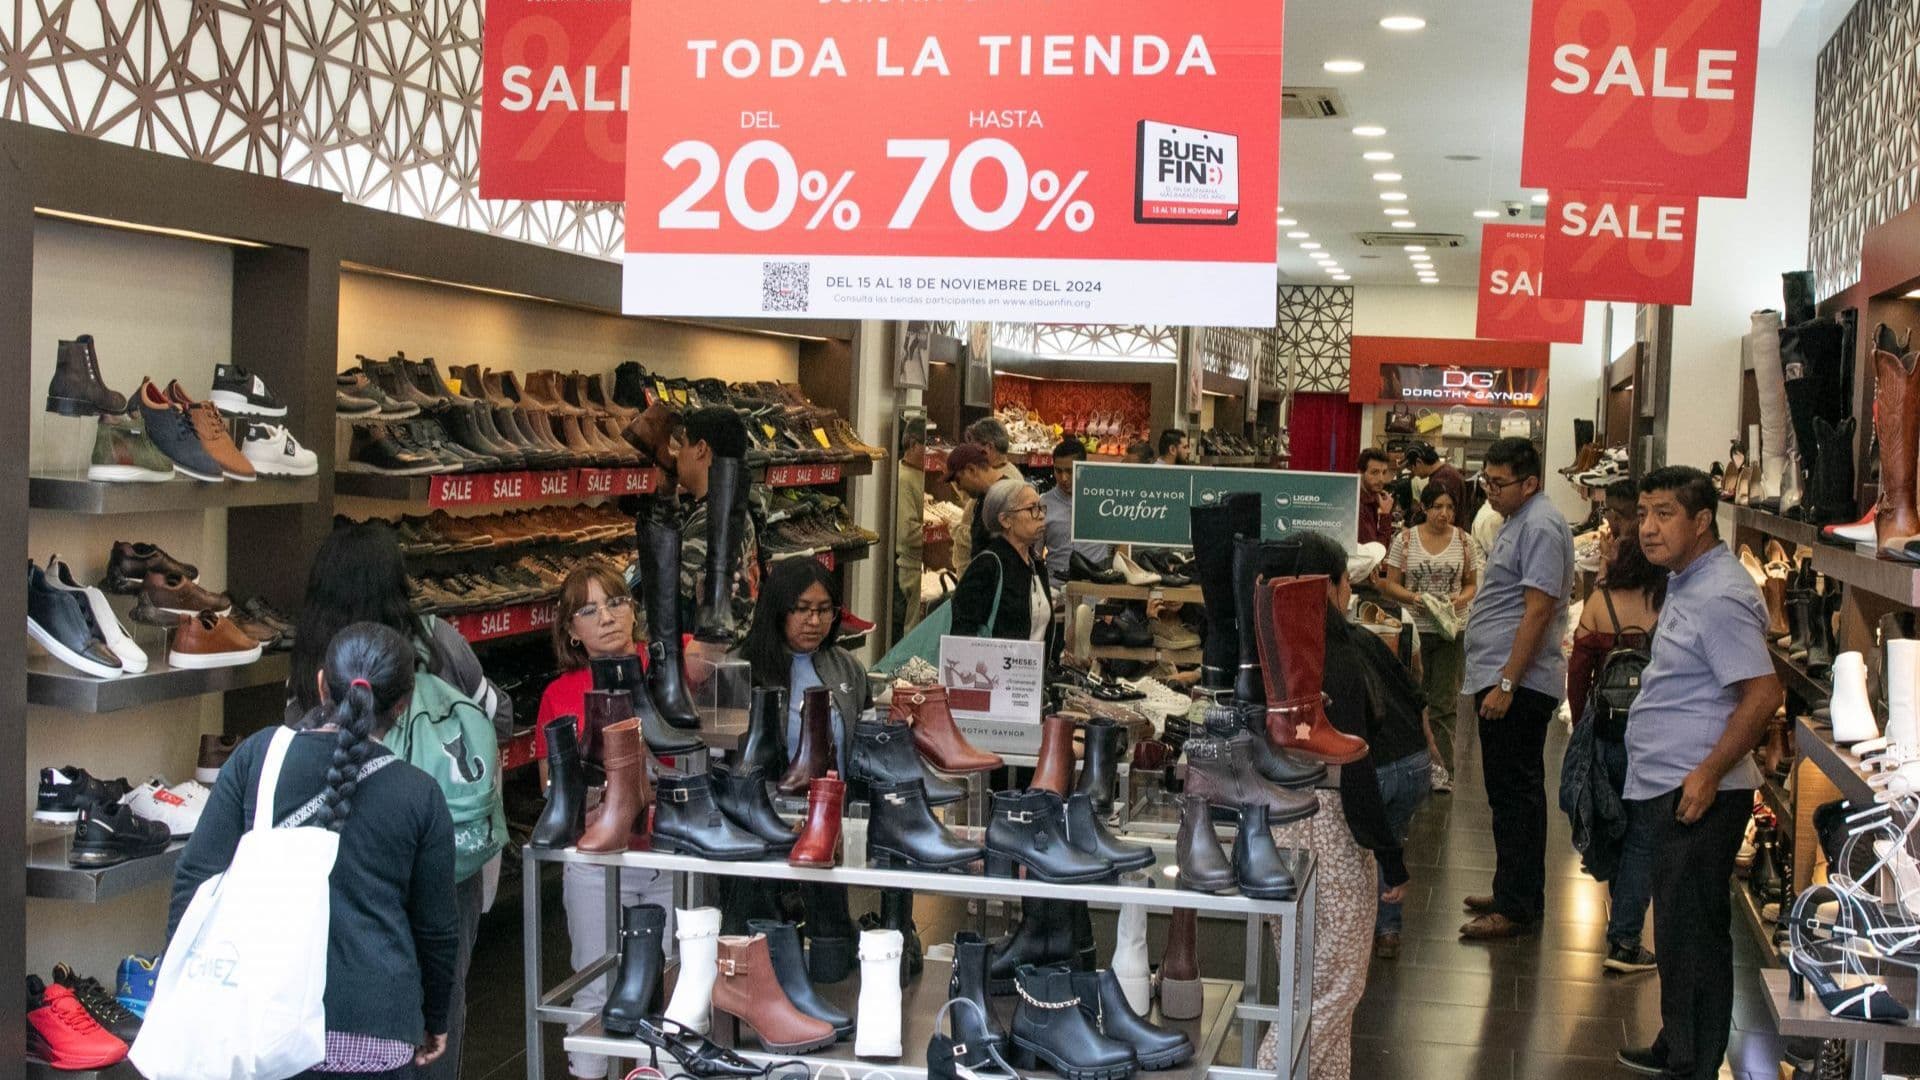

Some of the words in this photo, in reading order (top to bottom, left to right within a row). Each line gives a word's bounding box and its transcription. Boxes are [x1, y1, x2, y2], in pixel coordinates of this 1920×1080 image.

[688, 38, 847, 78] TODA
[876, 36, 950, 76] LA
[979, 35, 1217, 76] TIENDA
[1551, 43, 1737, 100] SALE
[500, 65, 630, 112] SAL
[741, 111, 780, 129] DEL
[969, 110, 1043, 129] HASTA
[1158, 138, 1223, 165] BUEN
[658, 139, 860, 231] 20%
[887, 138, 1096, 232] 70%
[1561, 202, 1685, 241] SALE
[1507, 231, 1538, 239] DOROTHY
[826, 276, 853, 288] DEL
[858, 277, 871, 288] 15
[876, 277, 893, 288] AL
[899, 277, 911, 289] 18
[916, 278, 935, 289] DE
[940, 278, 1027, 291] NOVIEMBRE
[1032, 280, 1061, 292] DEL
[1066, 280, 1102, 292] 2024
[833, 293, 873, 304] Consulta
[876, 294, 887, 304] las
[890, 294, 923, 305] tiendas
[925, 295, 986, 308] participantes
[988, 297, 999, 305] en
[1002, 296, 1091, 309] www.elbuenfin.org
[1442, 370, 1494, 389] DG
[1402, 387, 1471, 399] DOROTHY
[1474, 390, 1534, 400] GAYNOR
[771, 470, 788, 484] SALE
[796, 469, 812, 482] SALE
[821, 467, 836, 480] SALE
[441, 480, 472, 500] SALE
[493, 478, 522, 498] SALE
[541, 476, 568, 495] SALE
[587, 475, 611, 491] SALE
[626, 473, 649, 490] SALE
[1083, 487, 1135, 498] DOROTHY
[1140, 491, 1185, 500] GAYNOR
[1292, 494, 1320, 503] LIGERO
[1098, 498, 1168, 521] Confort
[481, 612, 511, 634] SALE
[1003, 656, 1012, 670] 3
[1012, 657, 1038, 666] MESES
[991, 728, 1025, 737] GAYNOR
